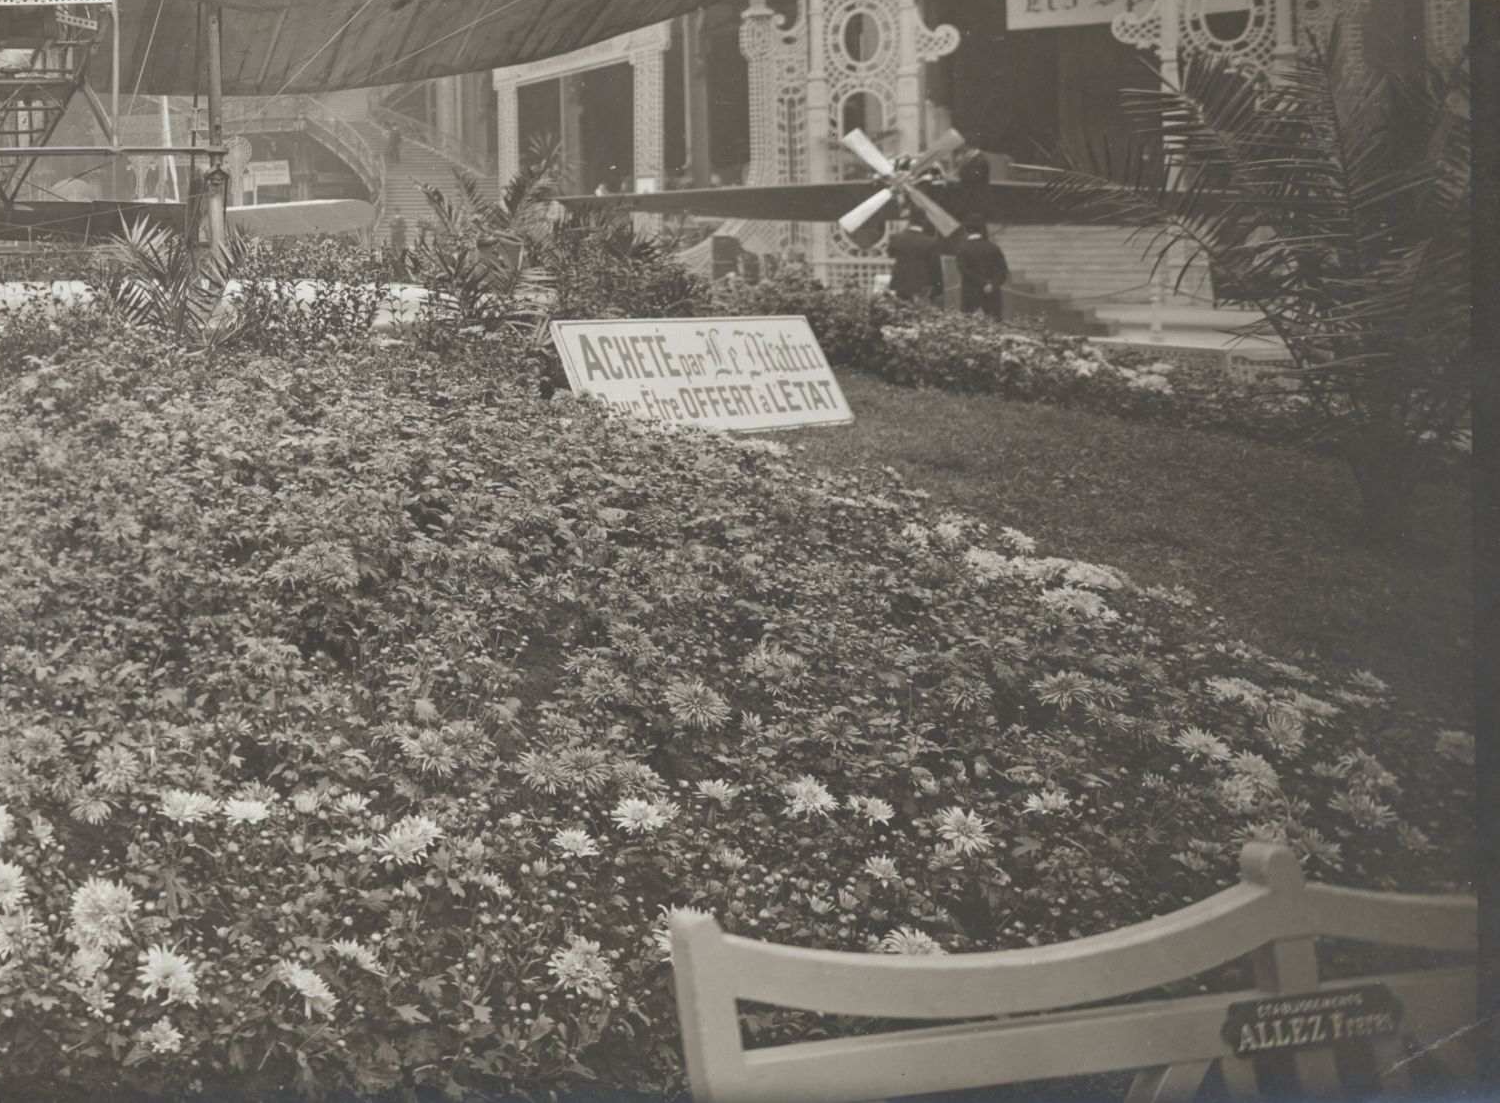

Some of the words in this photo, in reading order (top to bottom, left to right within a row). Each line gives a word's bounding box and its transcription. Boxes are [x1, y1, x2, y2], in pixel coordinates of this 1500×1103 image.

[678, 354, 706, 384] par
[678, 385, 760, 419] OFFERT
[1238, 1014, 1326, 1052] ALLEZ
